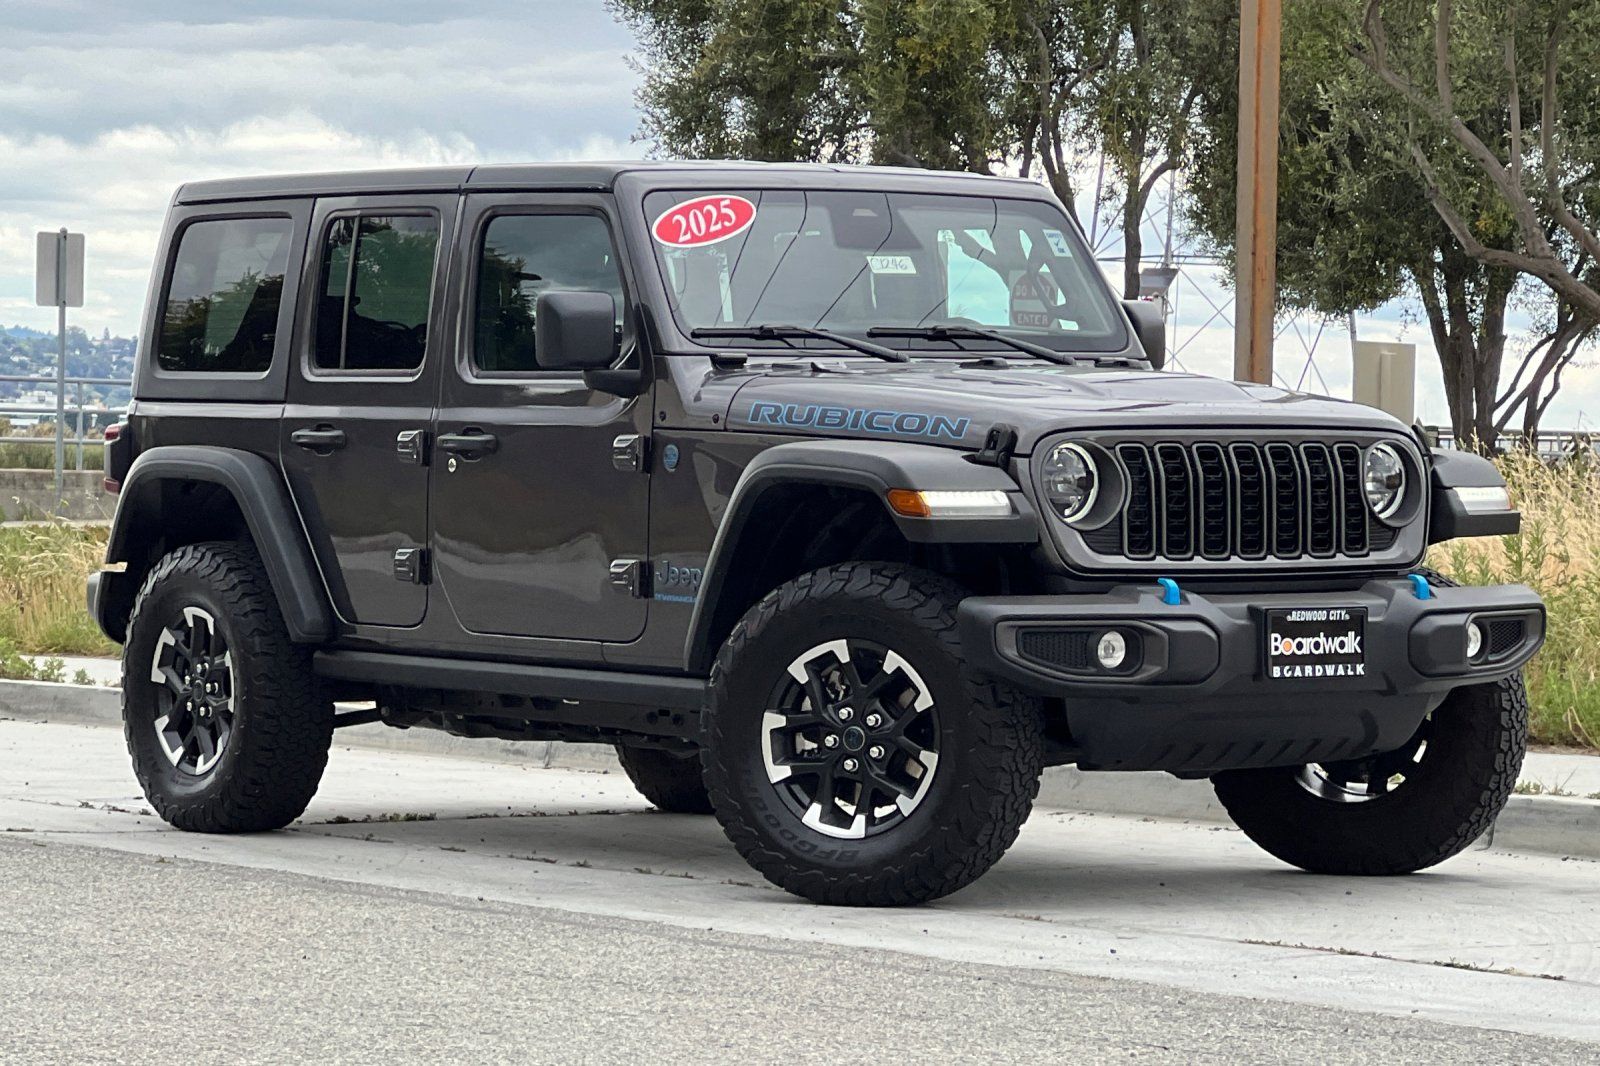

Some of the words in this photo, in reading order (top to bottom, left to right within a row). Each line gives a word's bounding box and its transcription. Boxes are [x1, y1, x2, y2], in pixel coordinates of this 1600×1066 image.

[671, 198, 737, 244] 2025
[1017, 313, 1049, 326] ENTER
[748, 401, 971, 440] RUBICON
[655, 560, 703, 592] Jeep
[1291, 610, 1328, 622] REDWOOD
[1329, 609, 1347, 621] CITY
[1270, 630, 1362, 656] Boardwalk
[1272, 663, 1366, 678] BOARDWALK
